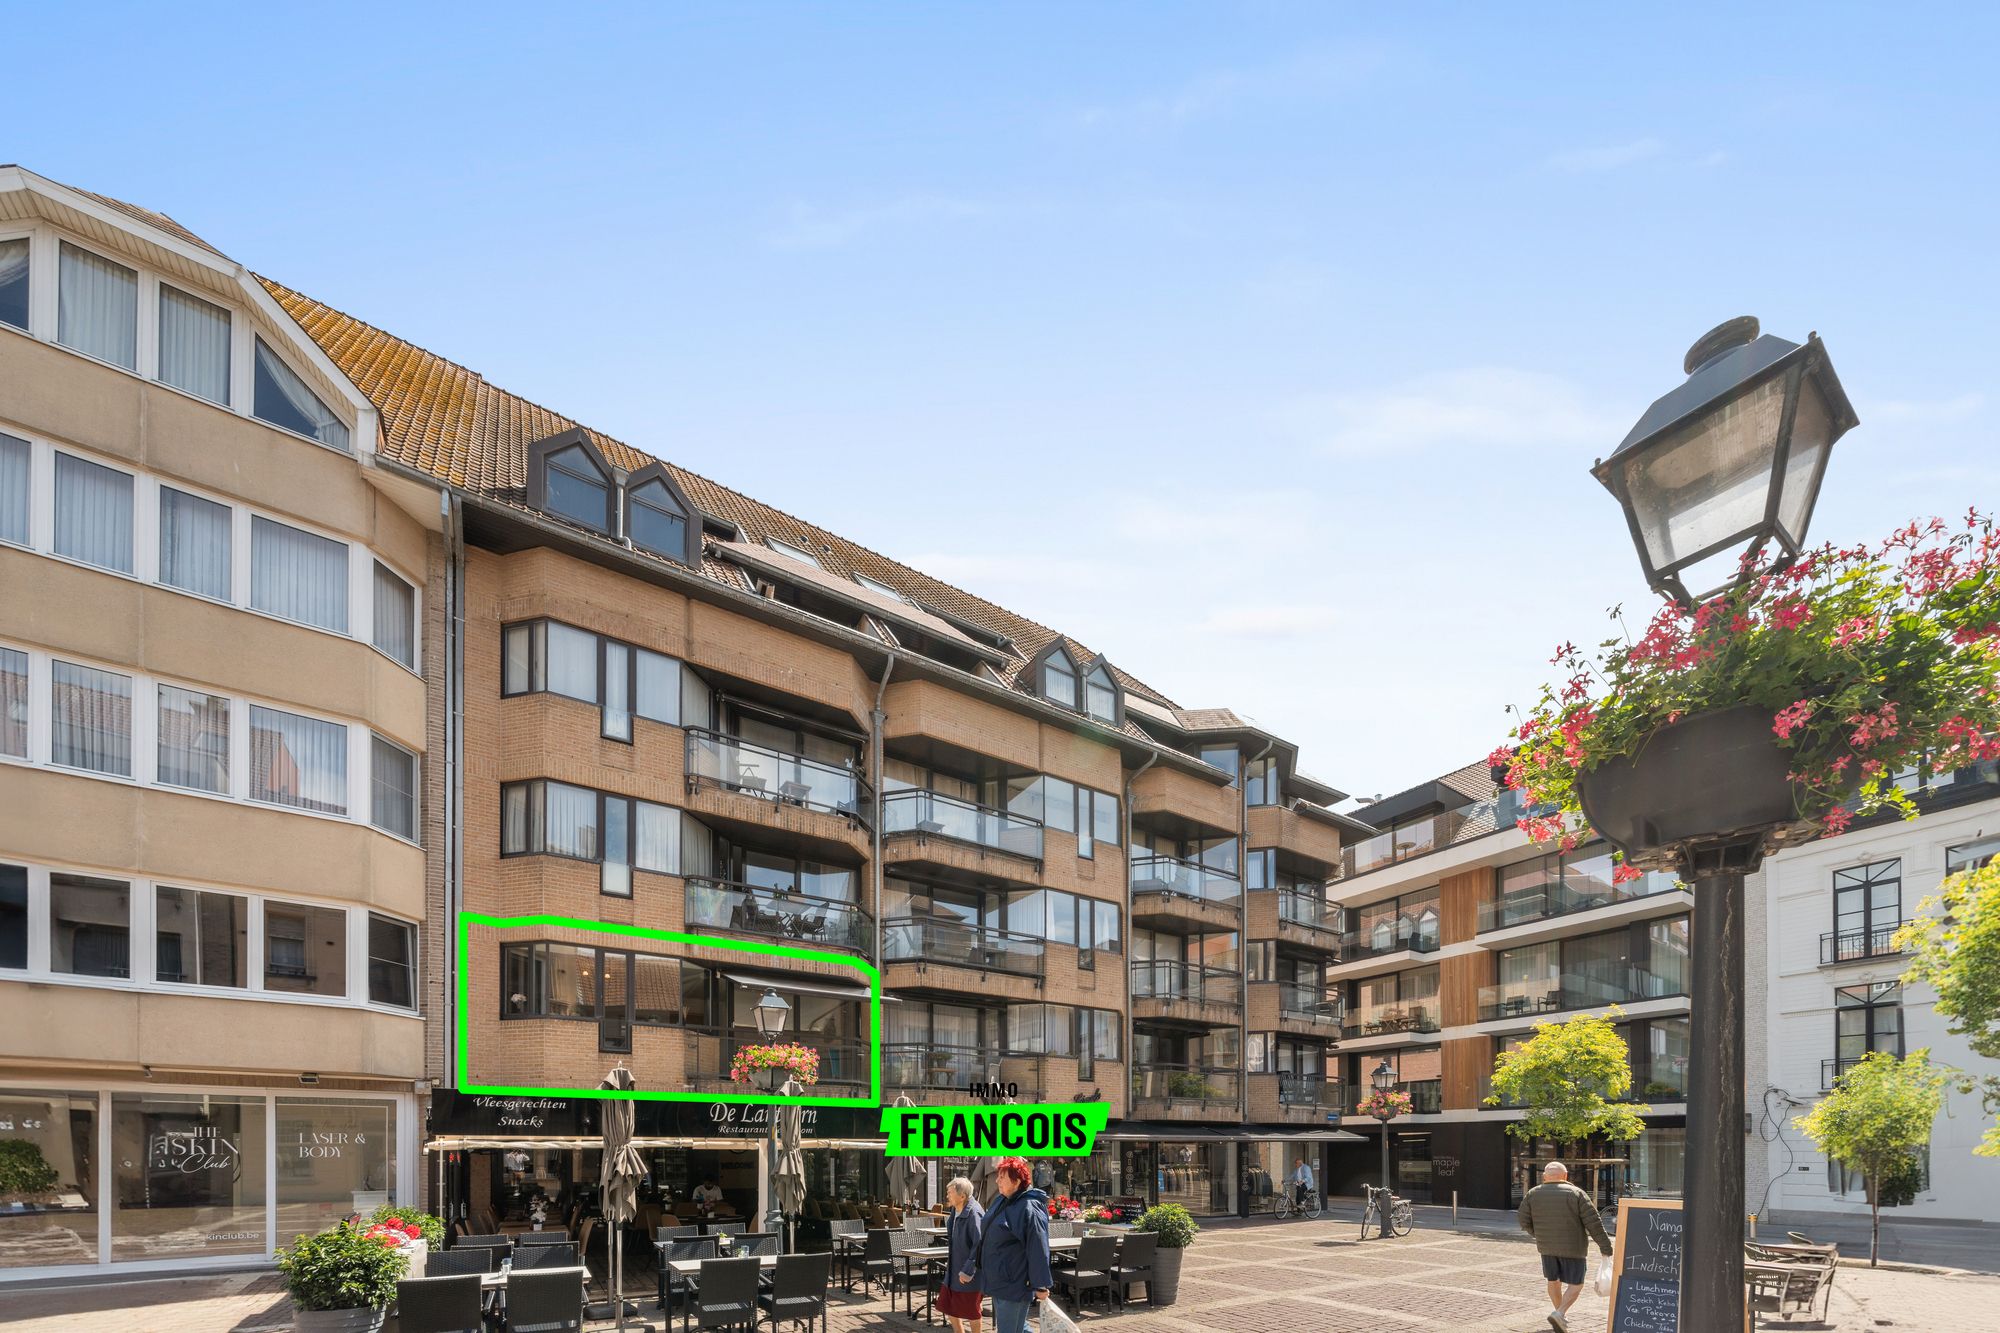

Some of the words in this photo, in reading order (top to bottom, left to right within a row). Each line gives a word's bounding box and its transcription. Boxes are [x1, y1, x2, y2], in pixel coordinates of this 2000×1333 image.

[473, 1097, 567, 1110] Vleesgerechten
[709, 1102, 737, 1122] De
[740, 1103, 818, 1123] Latrn
[497, 1115, 544, 1128] Snacks
[718, 1126, 768, 1134] Restaurant
[299, 1132, 348, 1144] LASER
[354, 1133, 366, 1144] &
[172, 1138, 240, 1155] SKIN
[299, 1146, 343, 1158] BODY
[181, 1153, 231, 1173] Club
[1432, 1156, 1460, 1169] maple
[1438, 1166, 1456, 1176] leaf
[207, 1232, 260, 1241] kinclub.be
[1626, 1254, 1681, 1275] Indisch
[1624, 1316, 1654, 1329] Chicken
